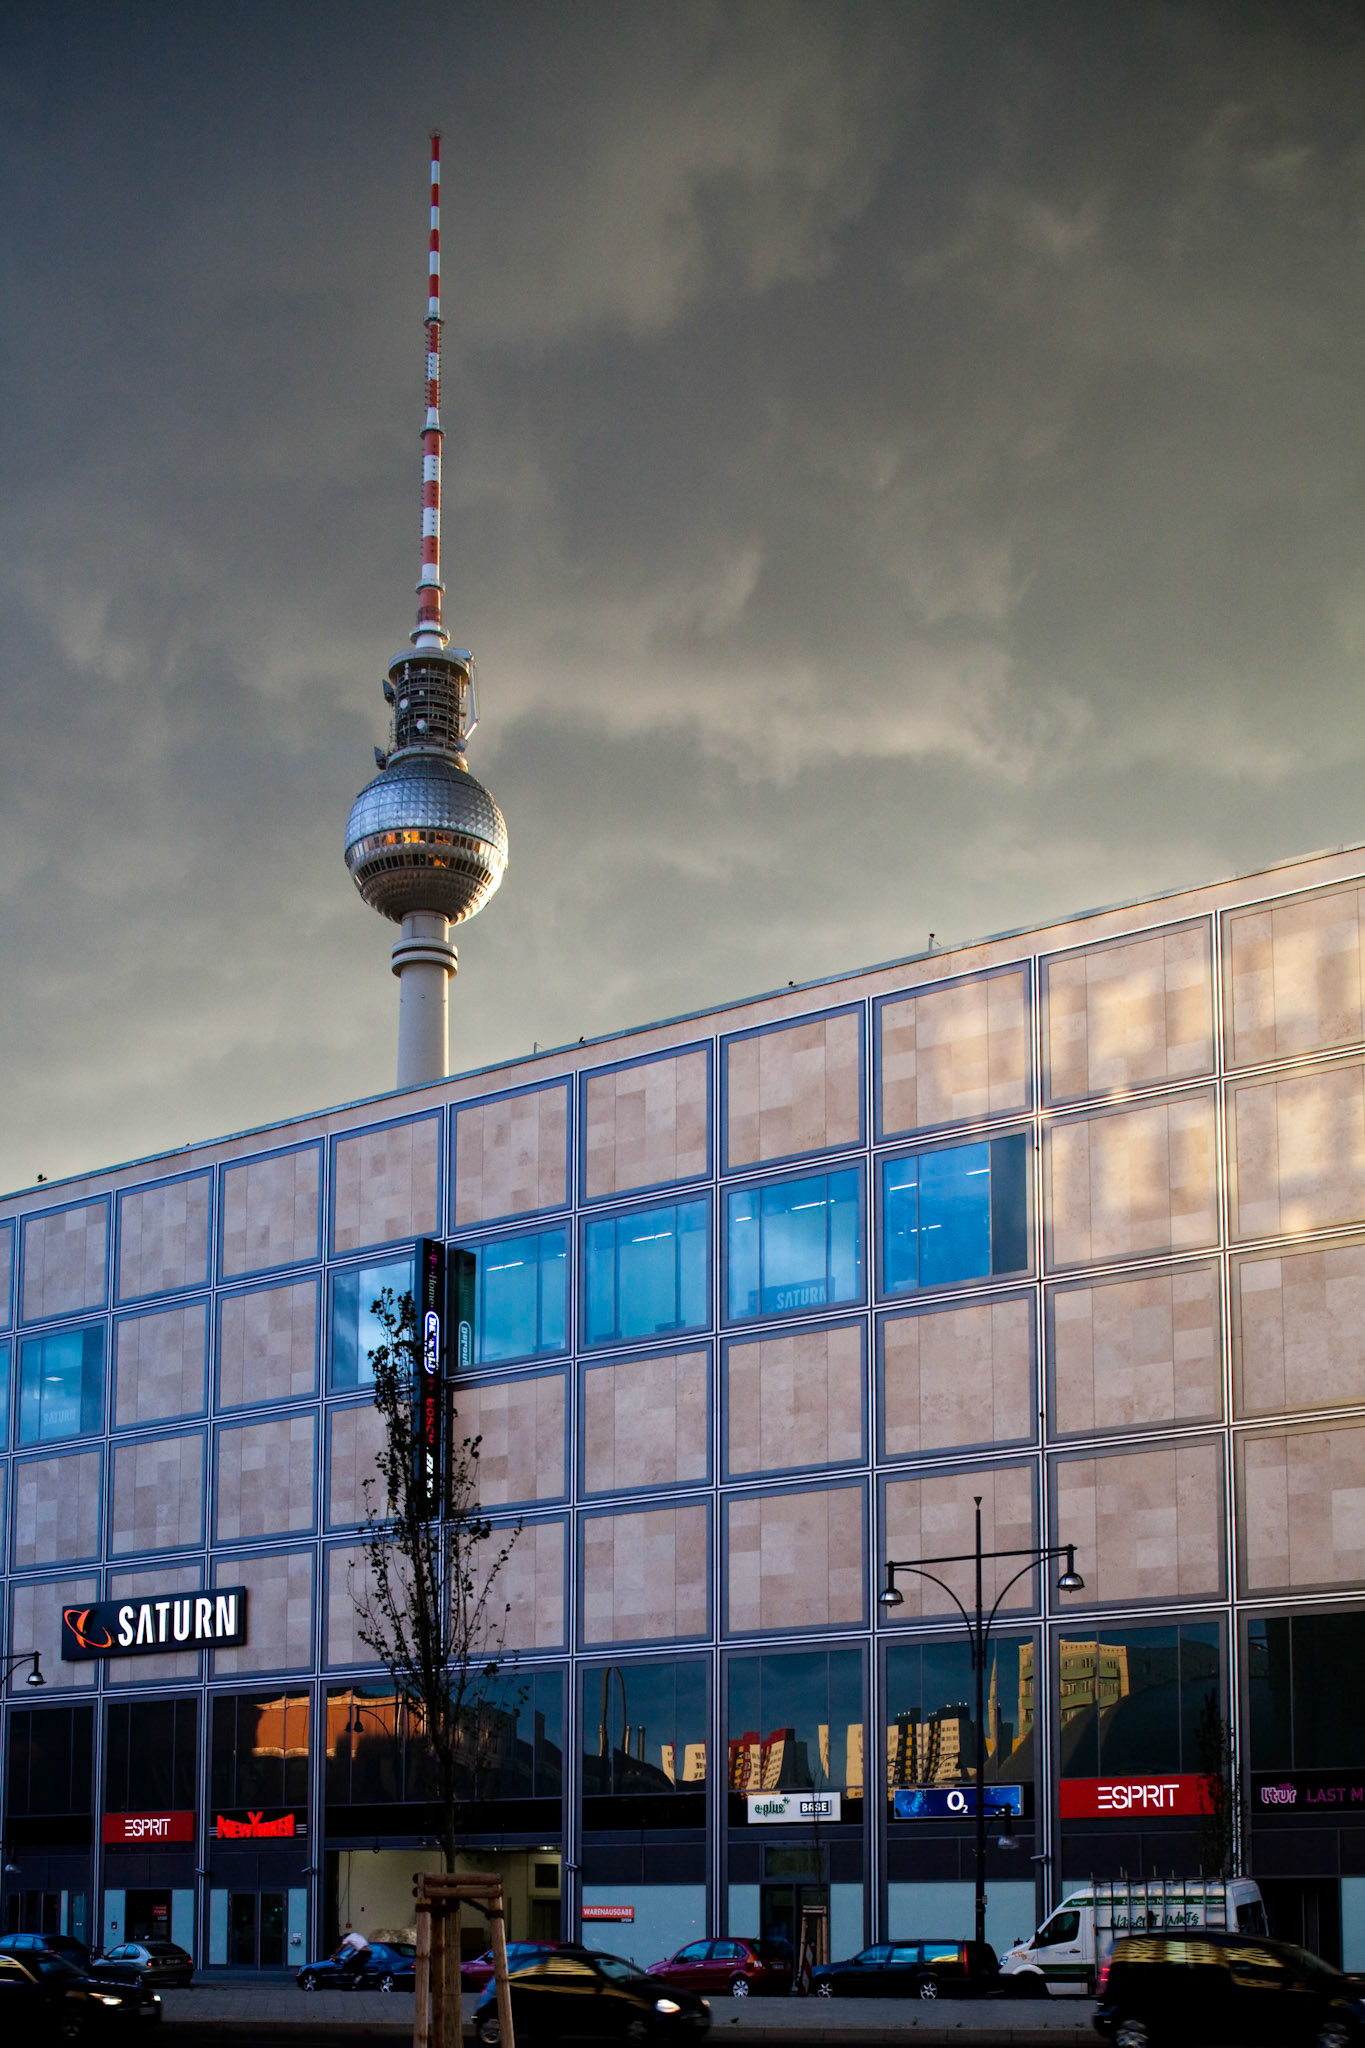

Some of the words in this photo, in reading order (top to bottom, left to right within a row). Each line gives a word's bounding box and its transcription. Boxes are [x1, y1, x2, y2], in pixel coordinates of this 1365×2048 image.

[428, 1274, 438, 1305] Home
[117, 1594, 239, 1647] SATURN
[1097, 1784, 1180, 1811] ESPRIT
[1305, 1787, 1346, 1803] LAST
[801, 1802, 828, 1813] BASE
[124, 1818, 172, 1837] ESPRIT
[583, 1907, 633, 1916] WARENAUSGABE
